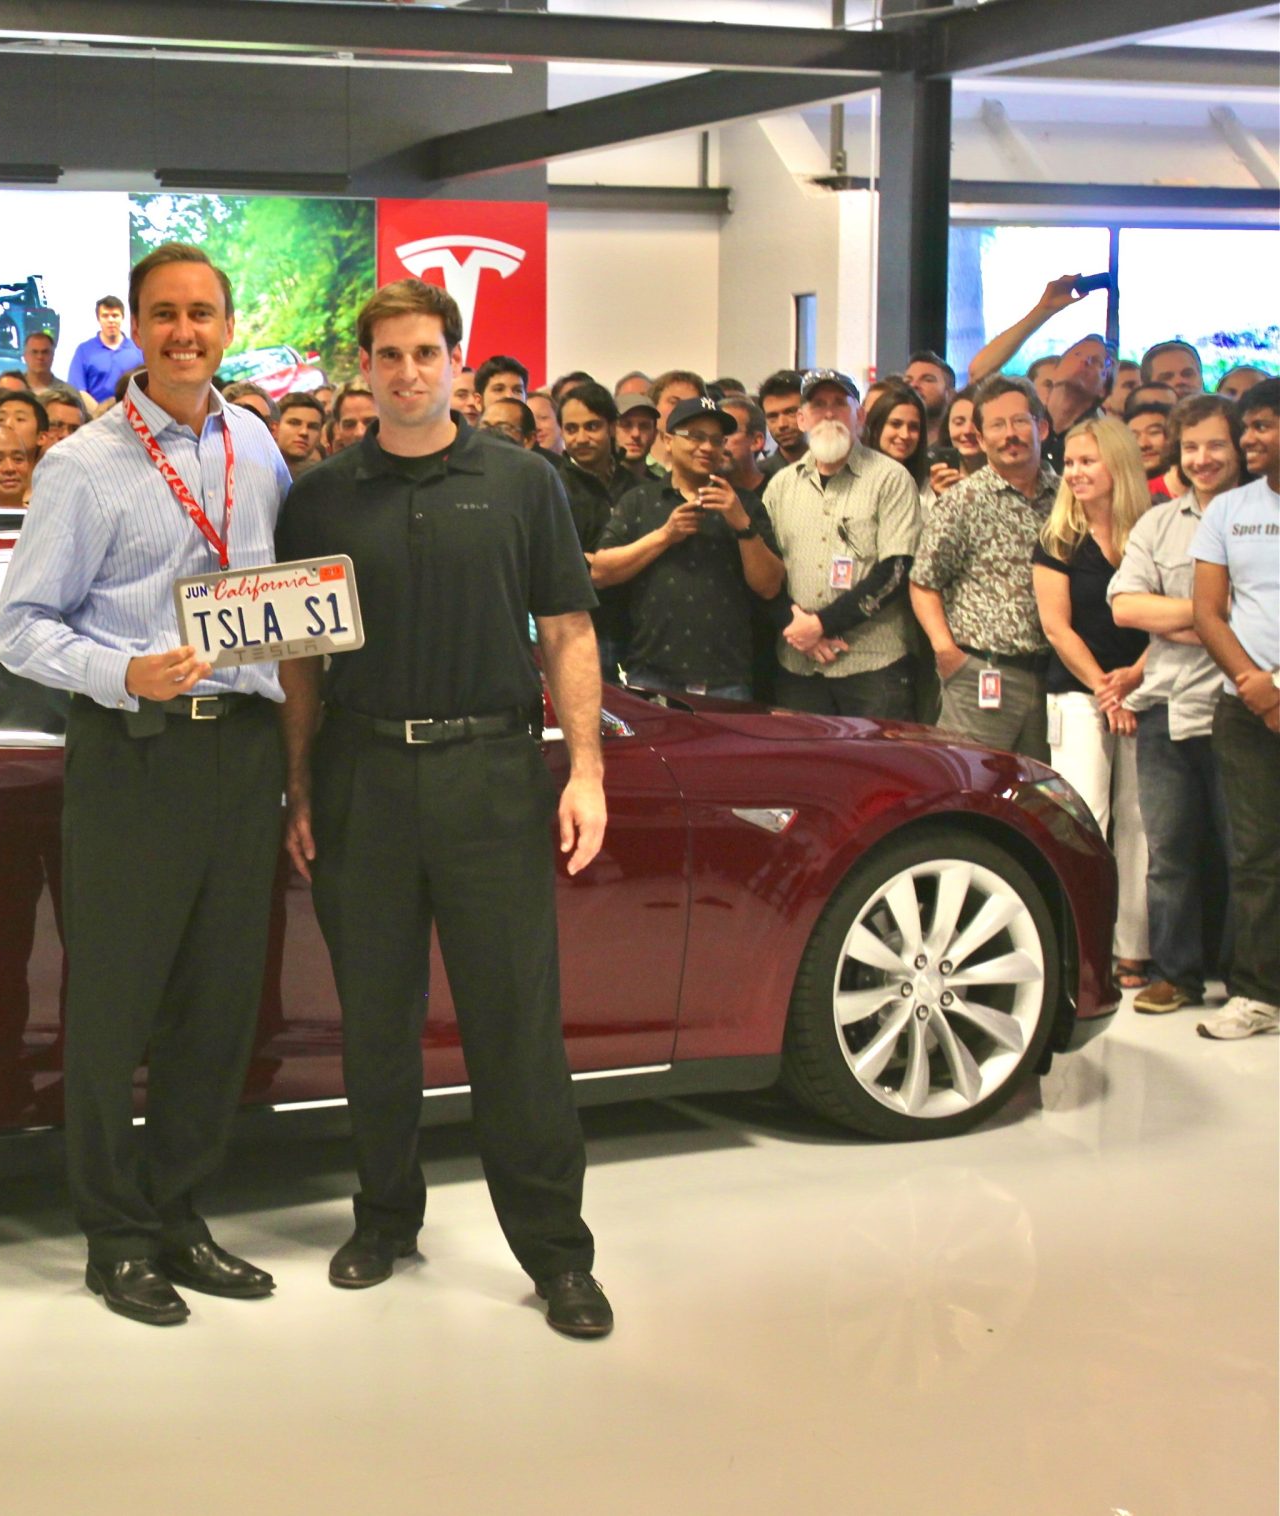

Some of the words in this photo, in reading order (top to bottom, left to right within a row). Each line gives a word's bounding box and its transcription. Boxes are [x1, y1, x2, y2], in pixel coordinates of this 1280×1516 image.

[1232, 523, 1262, 537] Spot
[185, 585, 208, 600] JUN
[214, 572, 320, 602] California
[193, 602, 283, 652] TSLA
[305, 592, 348, 636] S1
[234, 640, 318, 663] TESLA
